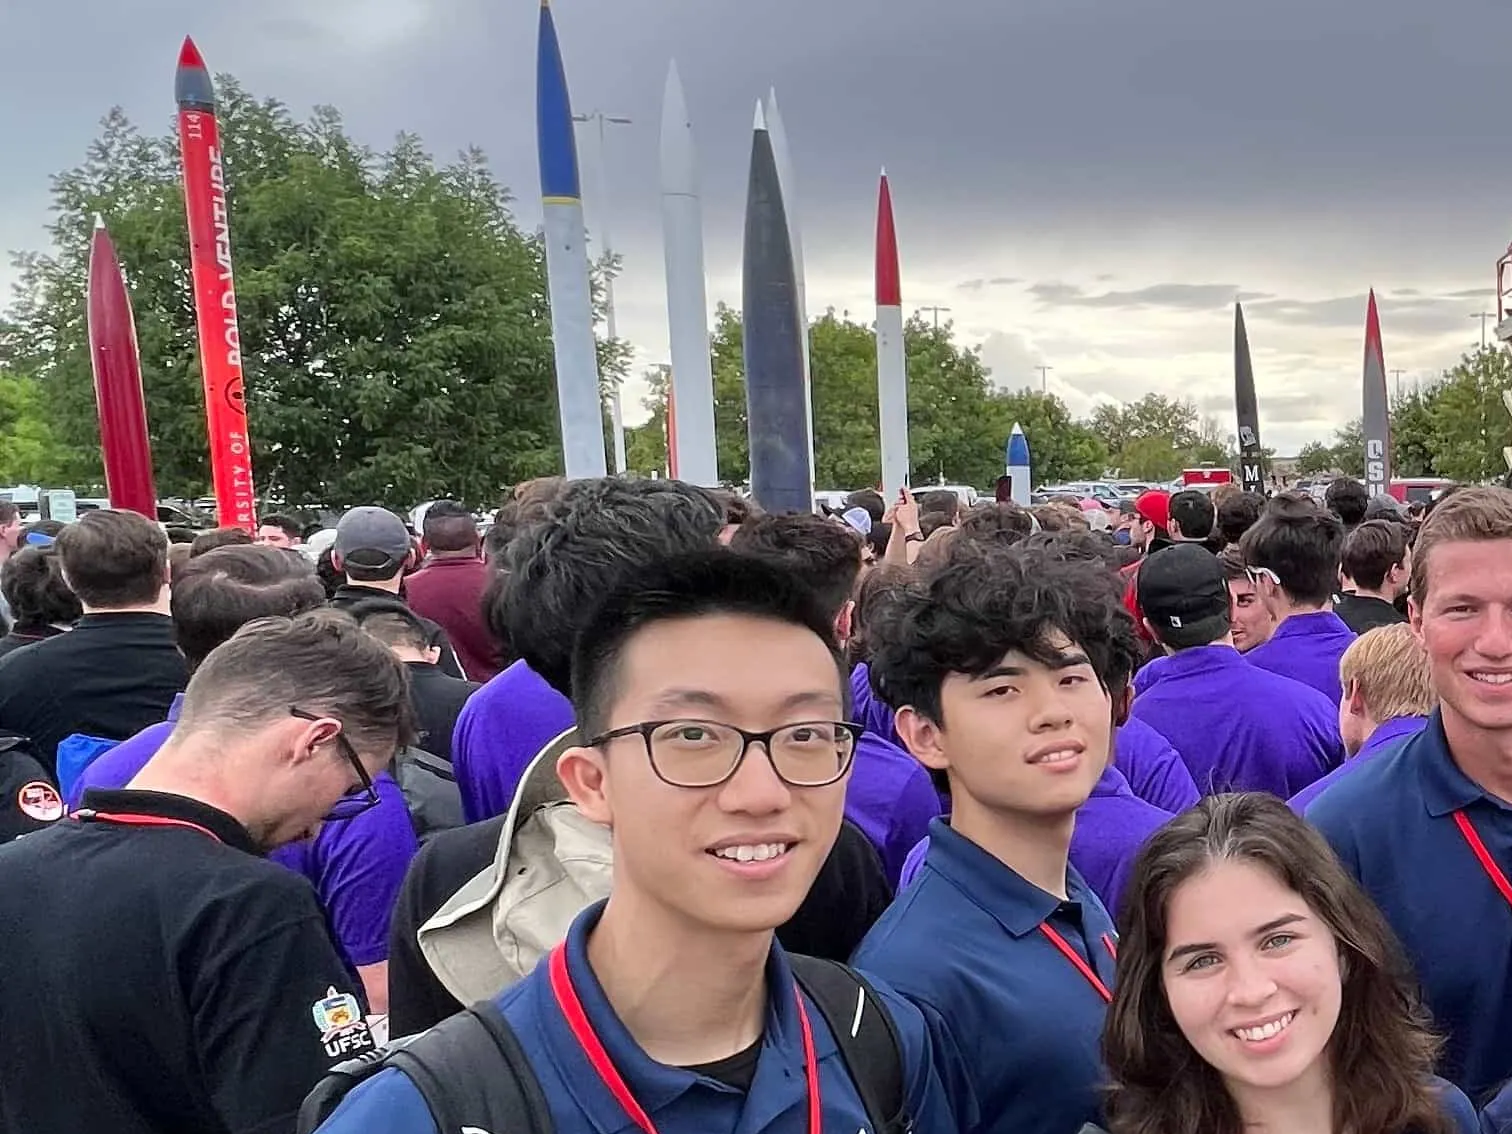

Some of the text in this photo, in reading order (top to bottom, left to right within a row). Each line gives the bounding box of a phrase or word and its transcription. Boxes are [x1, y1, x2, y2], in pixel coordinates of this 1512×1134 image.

[187, 115, 202, 140] 114
[208, 146, 233, 281] VENTURE
[229, 431, 245, 454] OF
[325, 1031, 371, 1057] UFSC
